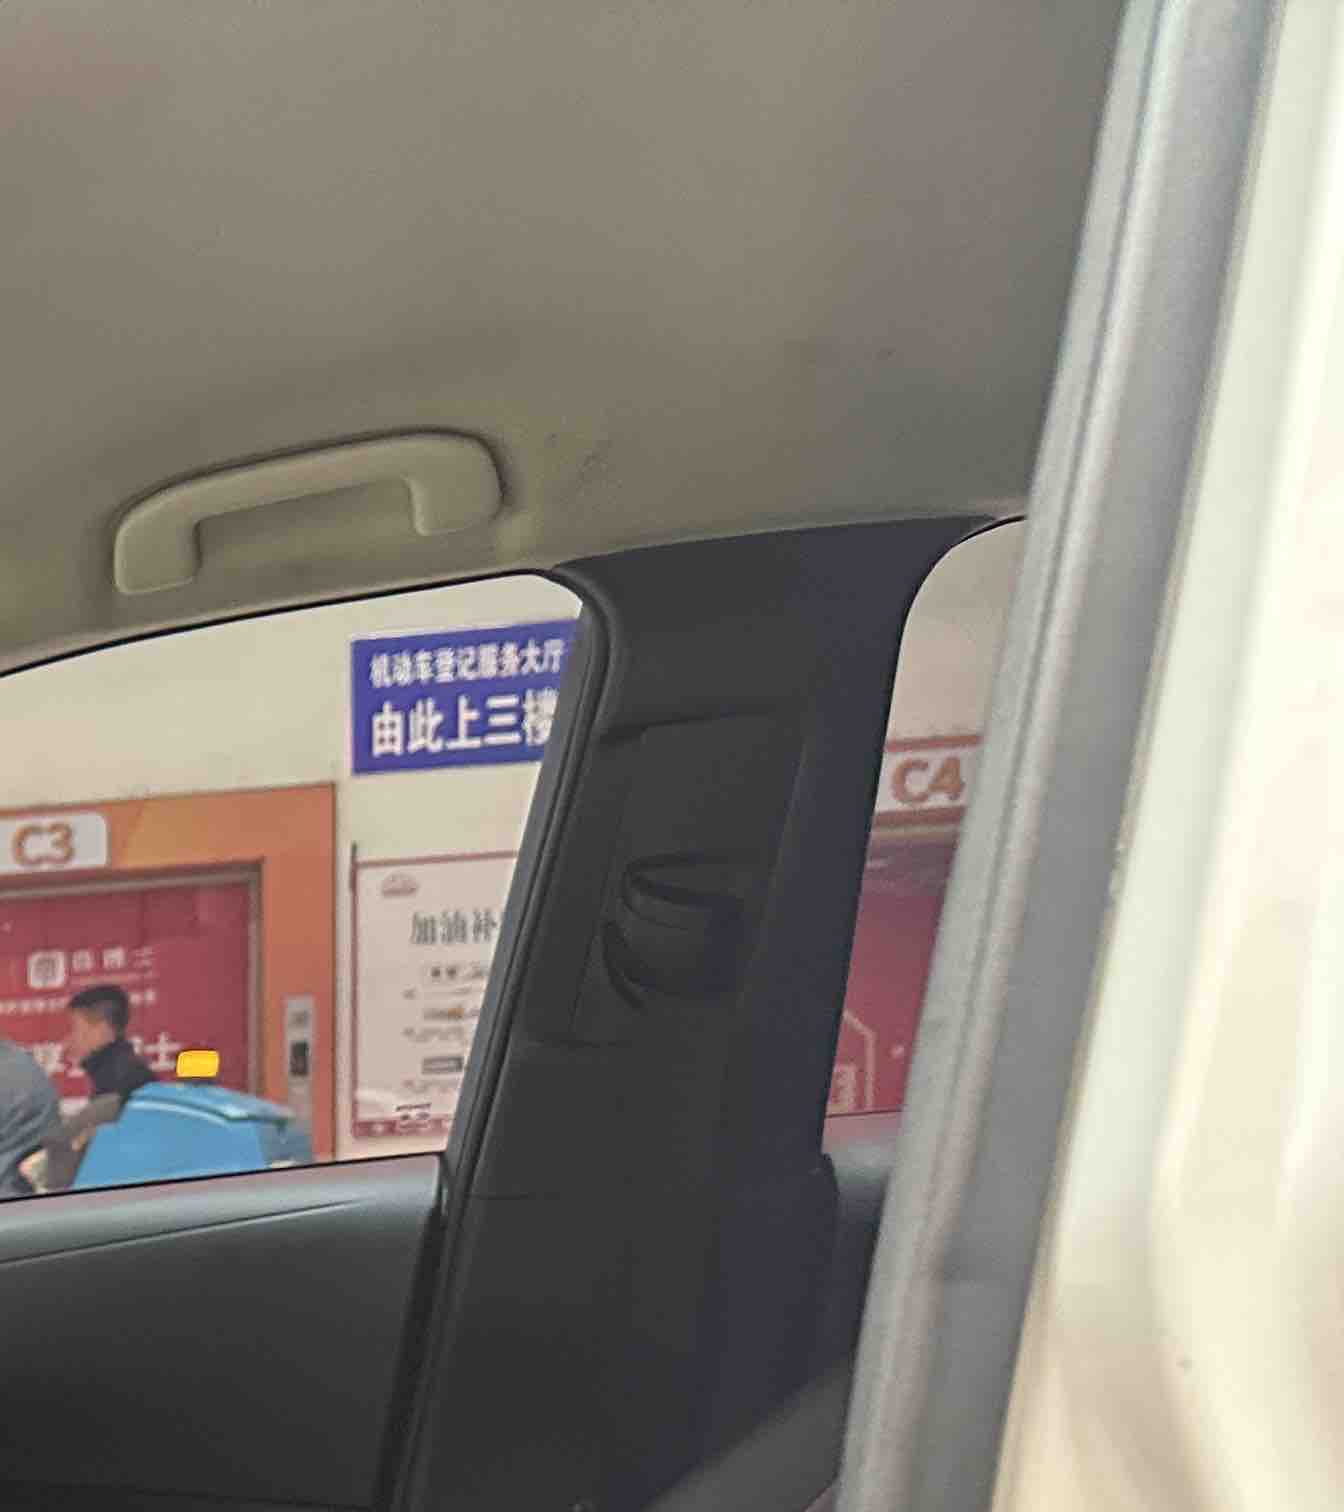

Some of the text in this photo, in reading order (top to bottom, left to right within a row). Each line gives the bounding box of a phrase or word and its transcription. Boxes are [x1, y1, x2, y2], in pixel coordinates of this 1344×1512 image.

[368, 638, 565, 688] 机动车登记服务大厅
[892, 756, 965, 803] C4
[13, 822, 76, 866] C3
